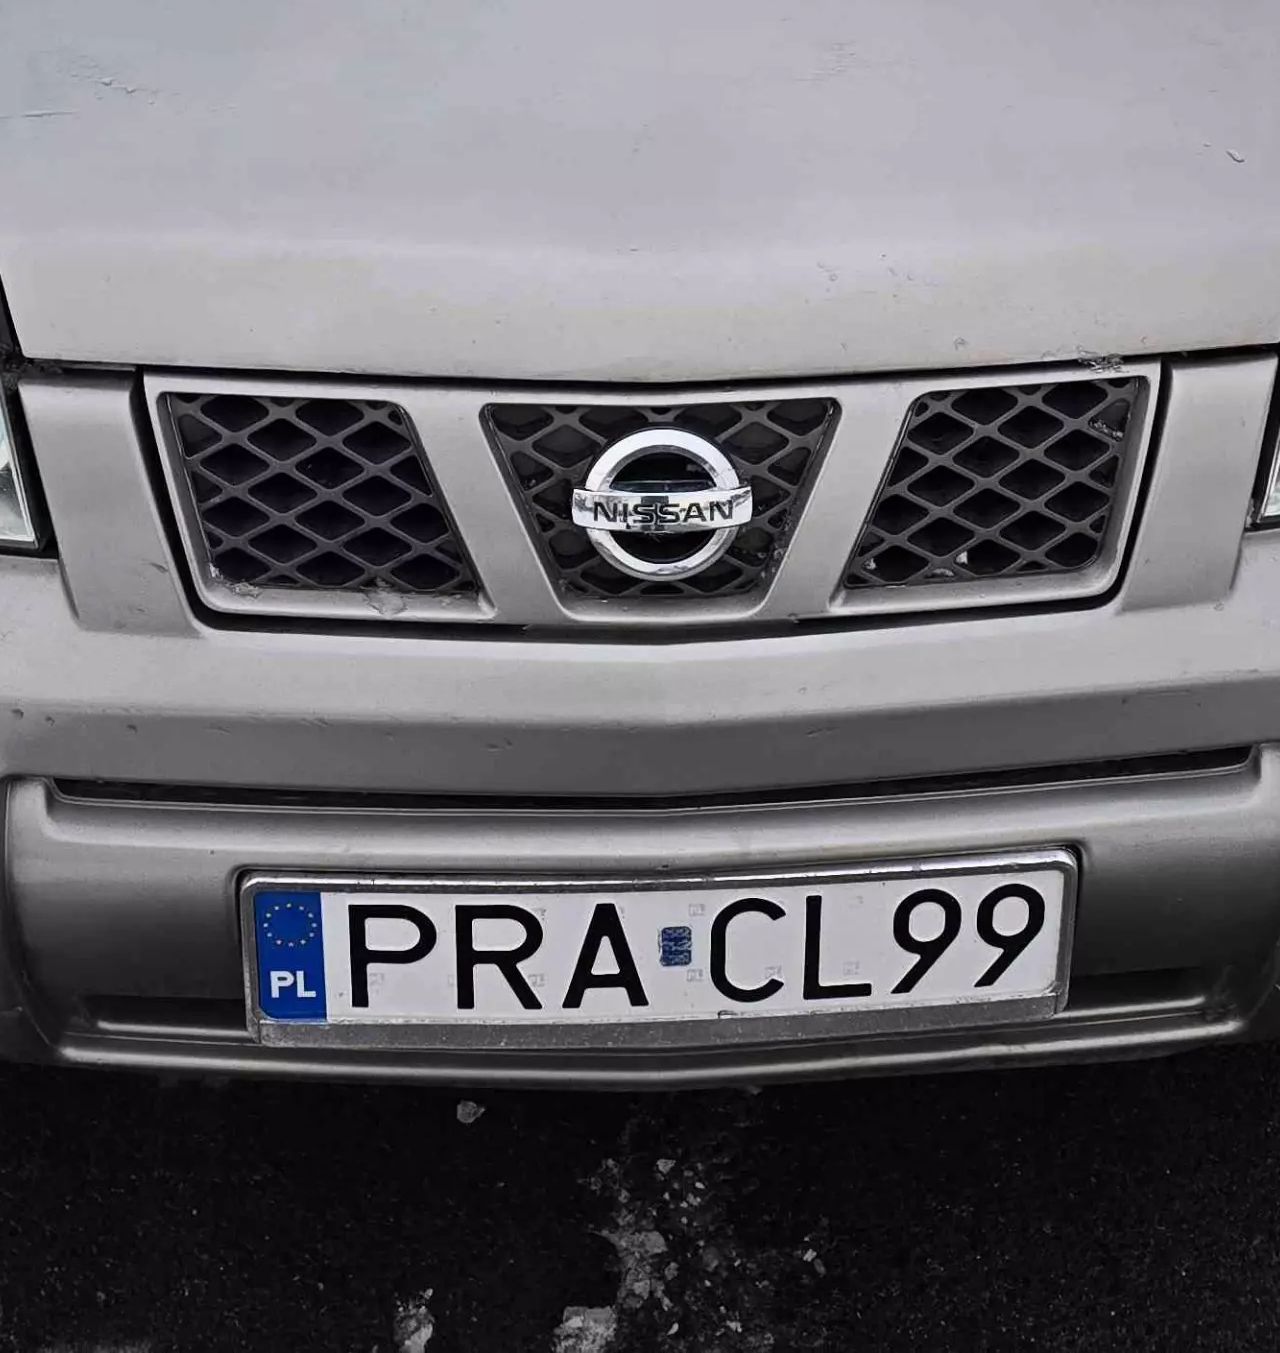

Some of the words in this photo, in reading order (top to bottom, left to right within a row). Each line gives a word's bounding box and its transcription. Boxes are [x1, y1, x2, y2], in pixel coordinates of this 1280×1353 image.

[593, 499, 733, 524] NISSAN
[347, 902, 649, 1010] PRA
[709, 882, 1046, 1004] CL99
[270, 970, 317, 998] PL
